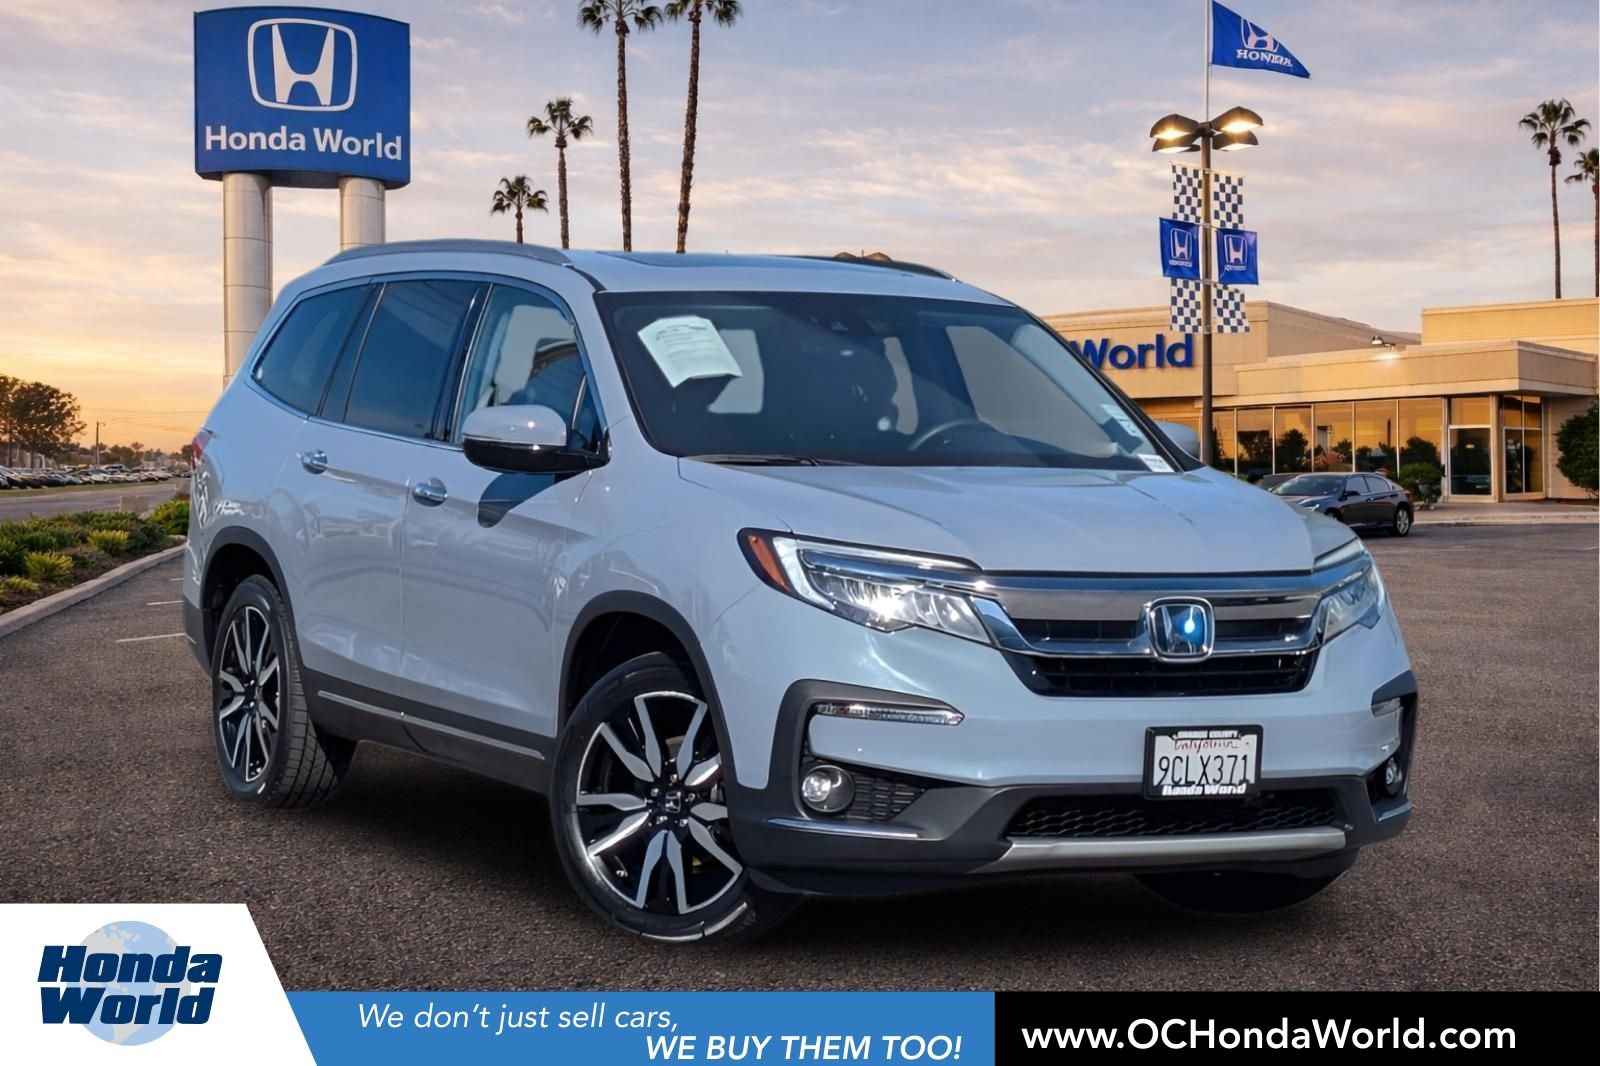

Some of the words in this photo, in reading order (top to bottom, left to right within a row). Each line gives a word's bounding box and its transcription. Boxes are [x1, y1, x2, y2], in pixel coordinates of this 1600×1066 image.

[205, 125, 306, 151] Honda
[312, 127, 402, 160] World
[1156, 754, 1249, 786] 9CLX371
